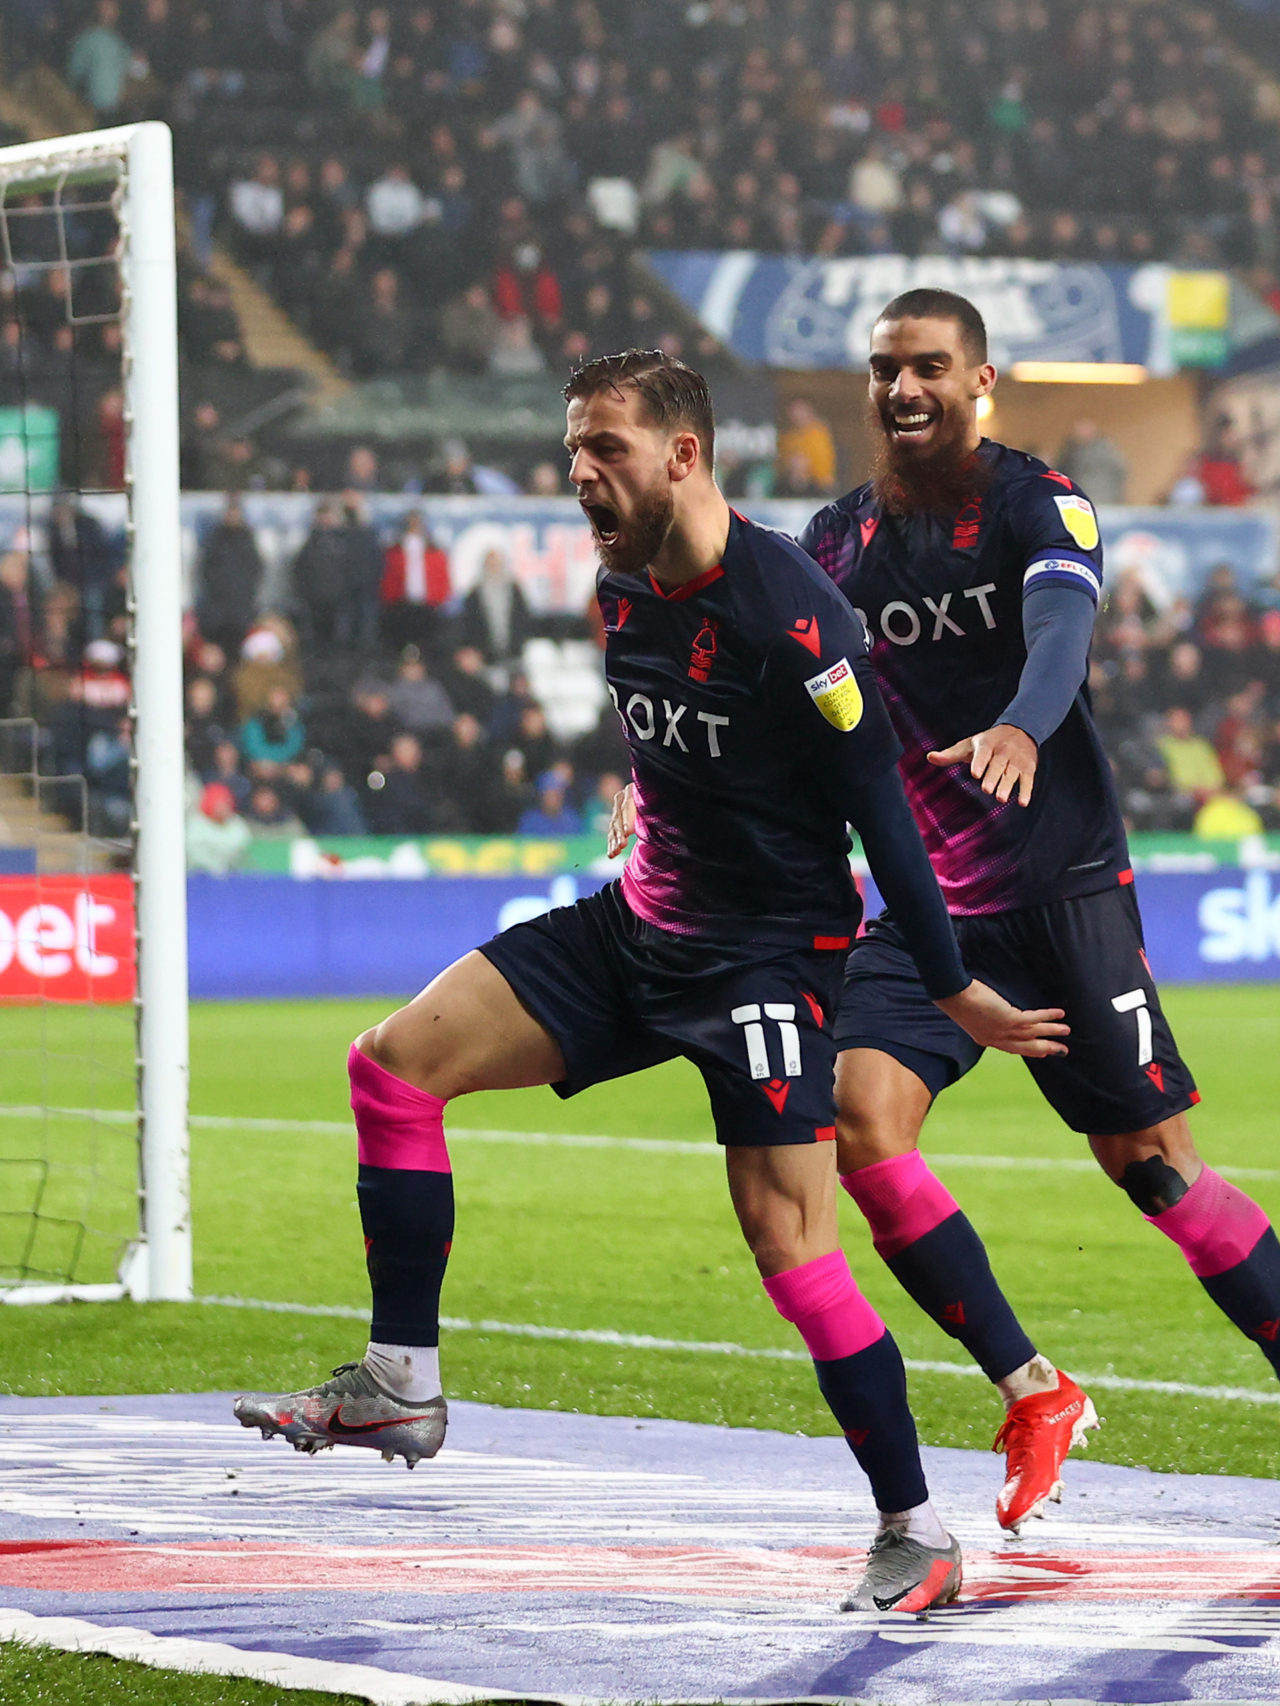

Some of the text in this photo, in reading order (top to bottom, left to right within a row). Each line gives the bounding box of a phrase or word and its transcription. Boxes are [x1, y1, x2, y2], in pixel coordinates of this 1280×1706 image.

[1060, 562, 1078, 571] EFL
[811, 664, 848, 692] sky bet
[0, 891, 119, 977] et
[731, 1003, 802, 1080] 11
[1110, 988, 1153, 1067] 7
